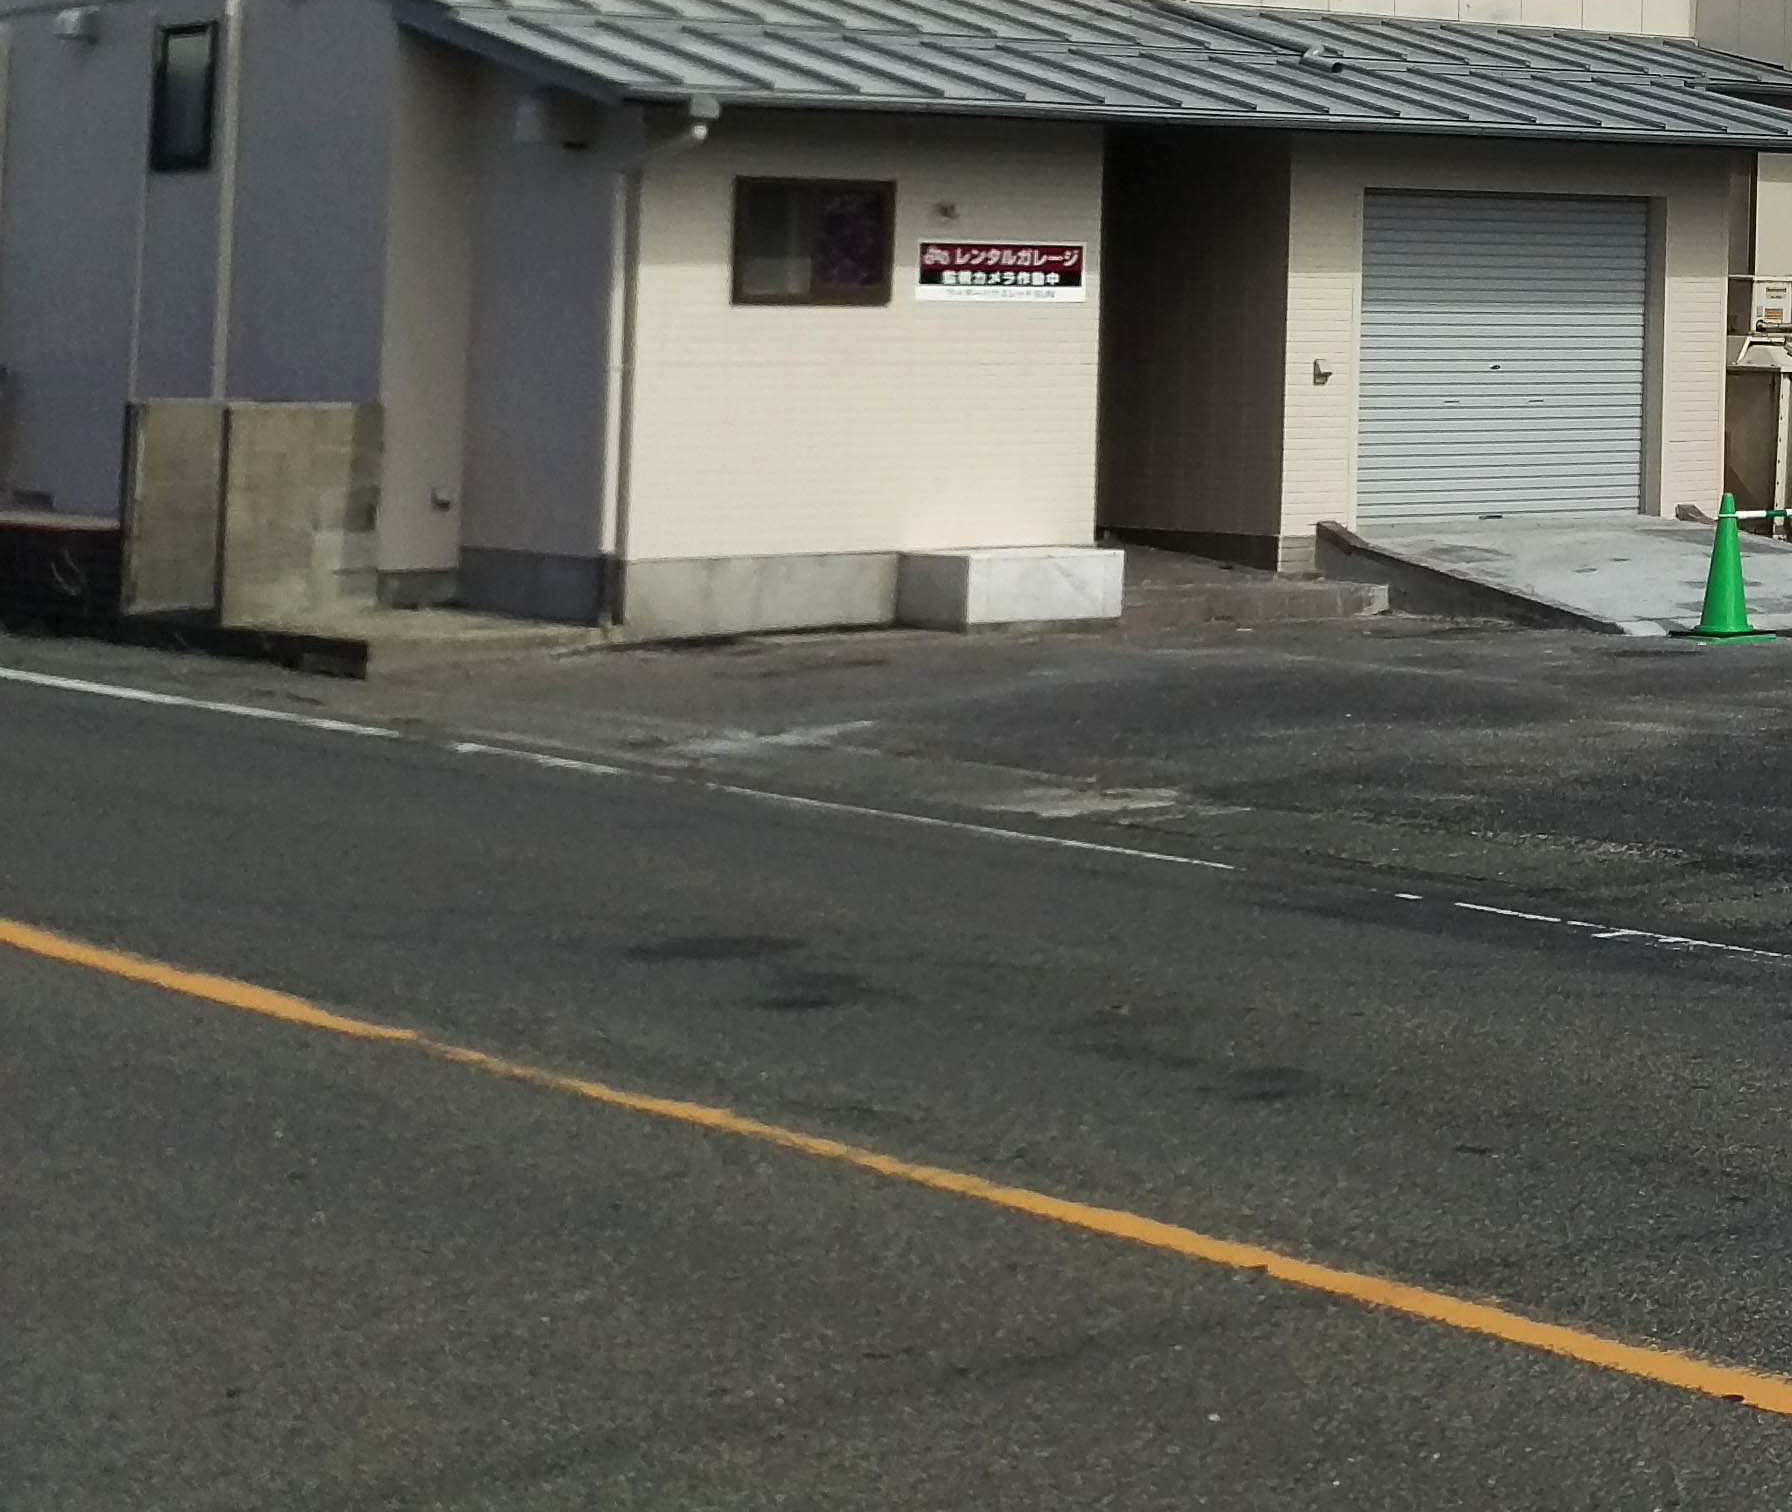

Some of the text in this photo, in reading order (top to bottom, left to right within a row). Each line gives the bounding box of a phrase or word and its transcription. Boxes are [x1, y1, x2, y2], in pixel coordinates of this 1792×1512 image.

[955, 248, 1078, 266] レンタルガレージ
